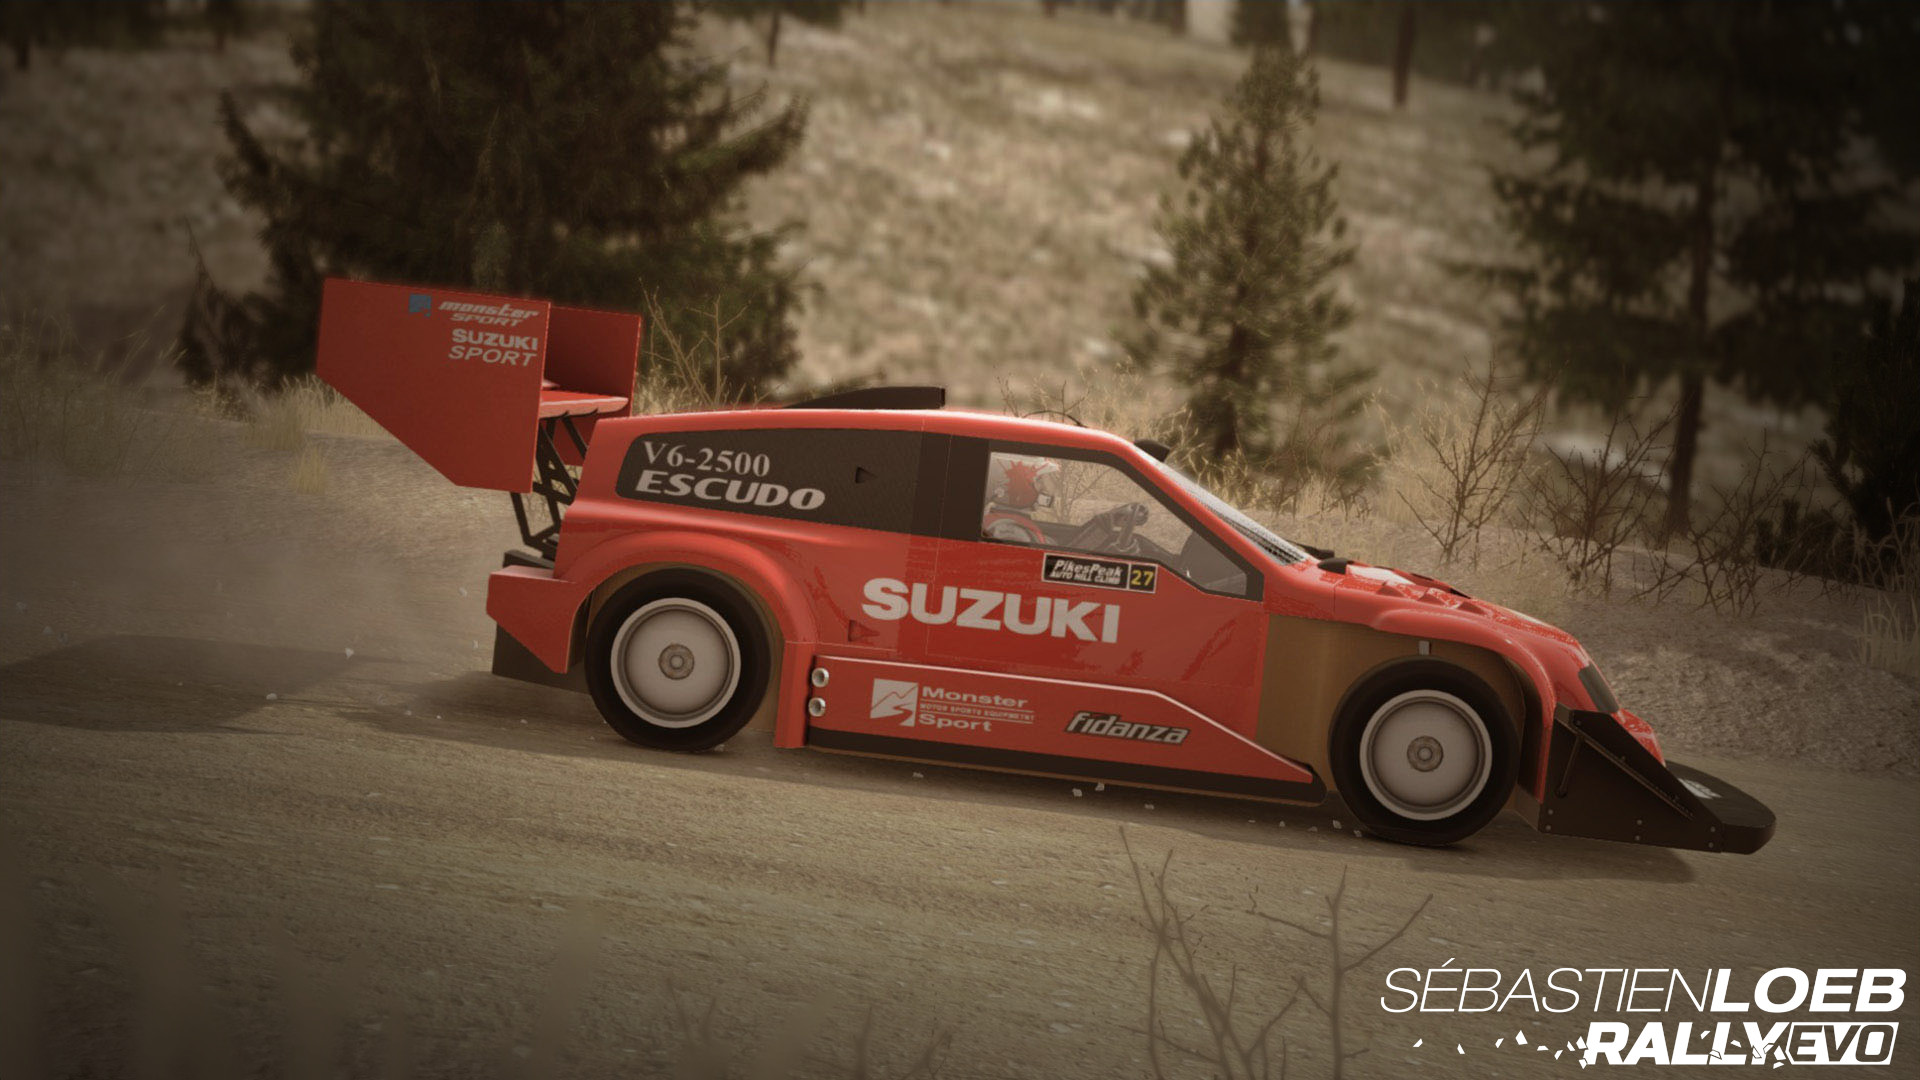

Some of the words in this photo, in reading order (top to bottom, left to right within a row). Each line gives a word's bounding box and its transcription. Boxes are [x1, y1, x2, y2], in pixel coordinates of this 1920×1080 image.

[450, 312, 524, 327] SPORT
[452, 328, 538, 350] SUZUKI
[449, 345, 537, 367] SPORT
[643, 441, 770, 477] V6-2500
[635, 469, 826, 510] ESCUDO
[1049, 571, 1072, 580] AUTO
[1131, 569, 1154, 586] 27
[861, 577, 1121, 644] SUZUKI
[919, 702, 948, 712] MOTOR
[922, 686, 1028, 708] Monster
[918, 713, 992, 732] Sport
